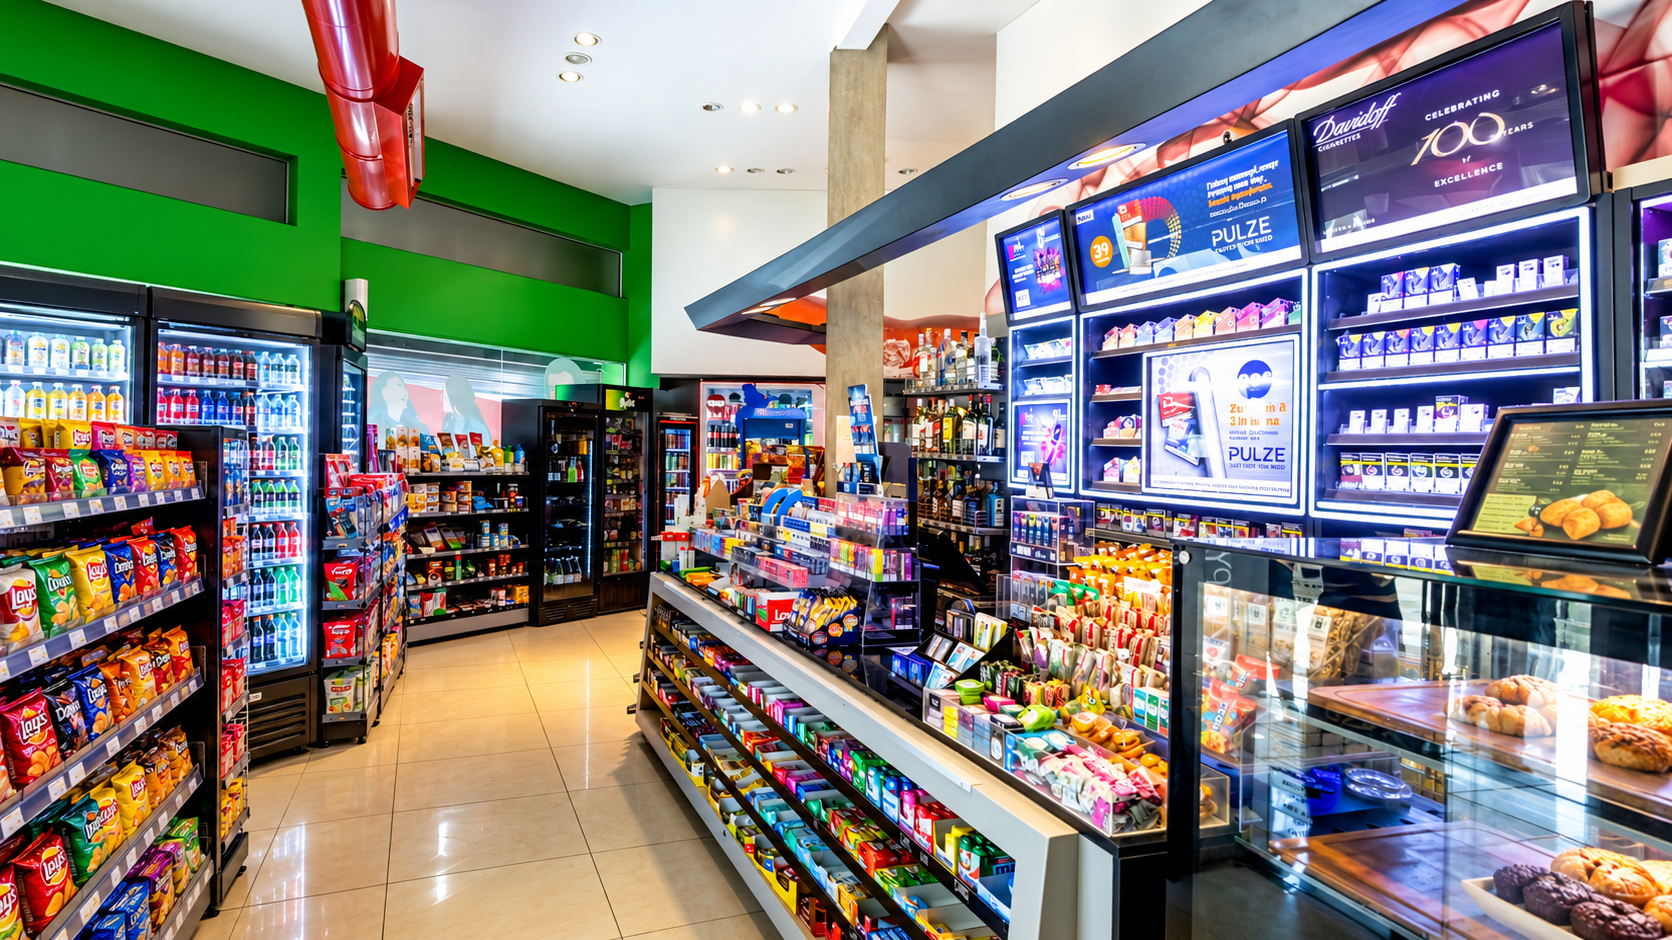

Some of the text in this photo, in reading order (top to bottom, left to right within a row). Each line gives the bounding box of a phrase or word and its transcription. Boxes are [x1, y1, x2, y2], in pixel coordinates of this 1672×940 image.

[1313, 92, 1401, 143] Davidoff
[1425, 89, 1500, 121] CELEBRATING
[1410, 112, 1534, 166] 100 YEARS
[1434, 162, 1503, 188] EXCELLENCE
[1211, 215, 1272, 247] PULZE
[1093, 241, 1109, 259] 39
[1229, 446, 1286, 463] PULZE
